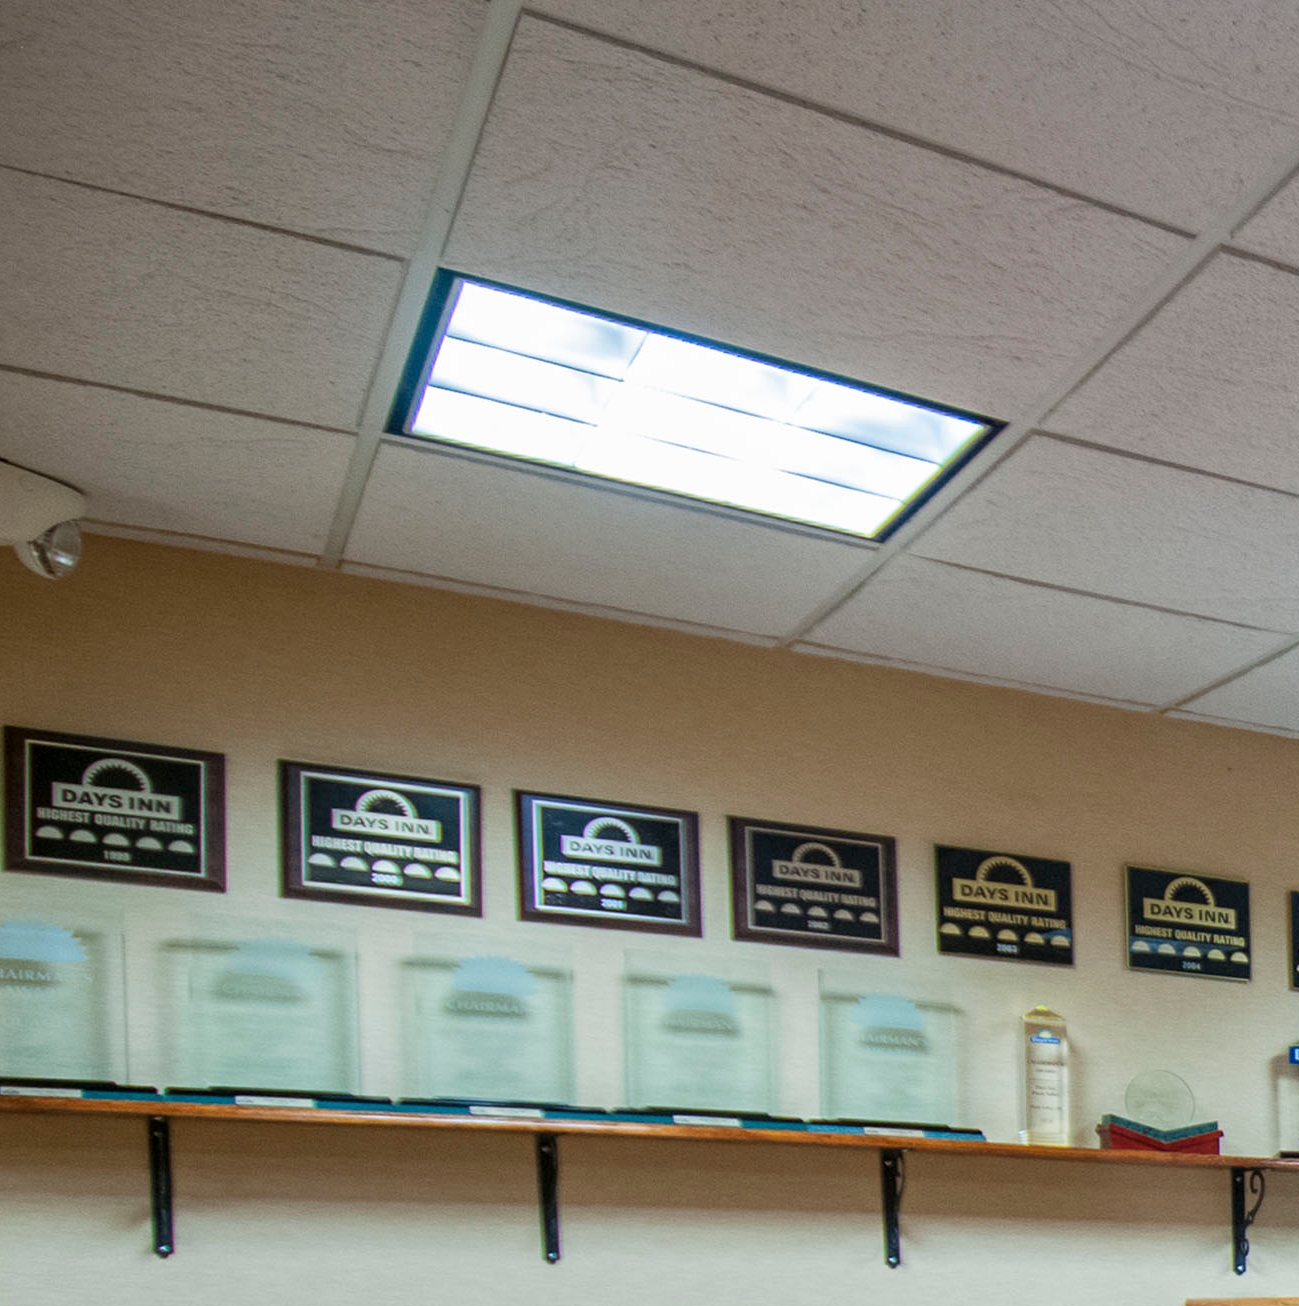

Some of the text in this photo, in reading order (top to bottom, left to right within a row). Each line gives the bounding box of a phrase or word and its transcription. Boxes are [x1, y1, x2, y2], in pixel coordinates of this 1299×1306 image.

[61, 789, 172, 814] DAYS INN
[36, 807, 194, 835] HIGHEST QUALITY RATING
[340, 814, 429, 834] DAYS INN
[569, 840, 652, 859] DAYS INN
[778, 864, 855, 883] DAYS INN
[960, 884, 1049, 906] DAYS INN
[1150, 903, 1229, 924] DAYS INN
[1174, 929, 1211, 943] QUALITY
